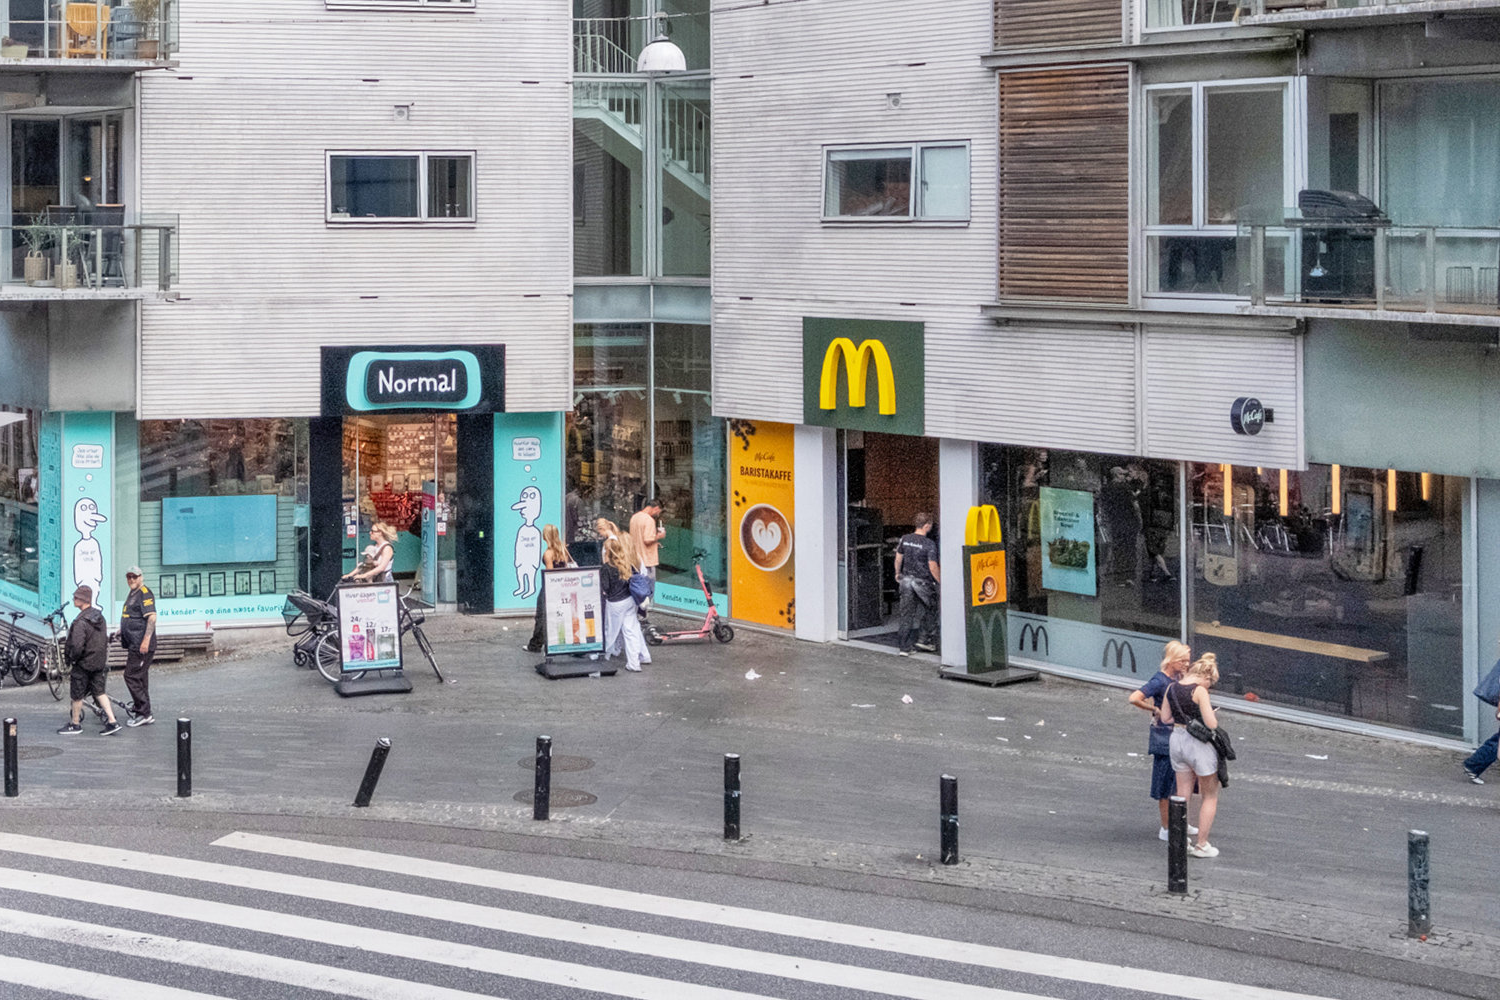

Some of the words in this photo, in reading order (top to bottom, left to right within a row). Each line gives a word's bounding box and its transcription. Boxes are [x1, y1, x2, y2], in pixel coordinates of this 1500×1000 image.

[378, 367, 457, 394] Normal
[740, 465, 792, 481] BARISTAKAFFE
[171, 608, 196, 616] kender
